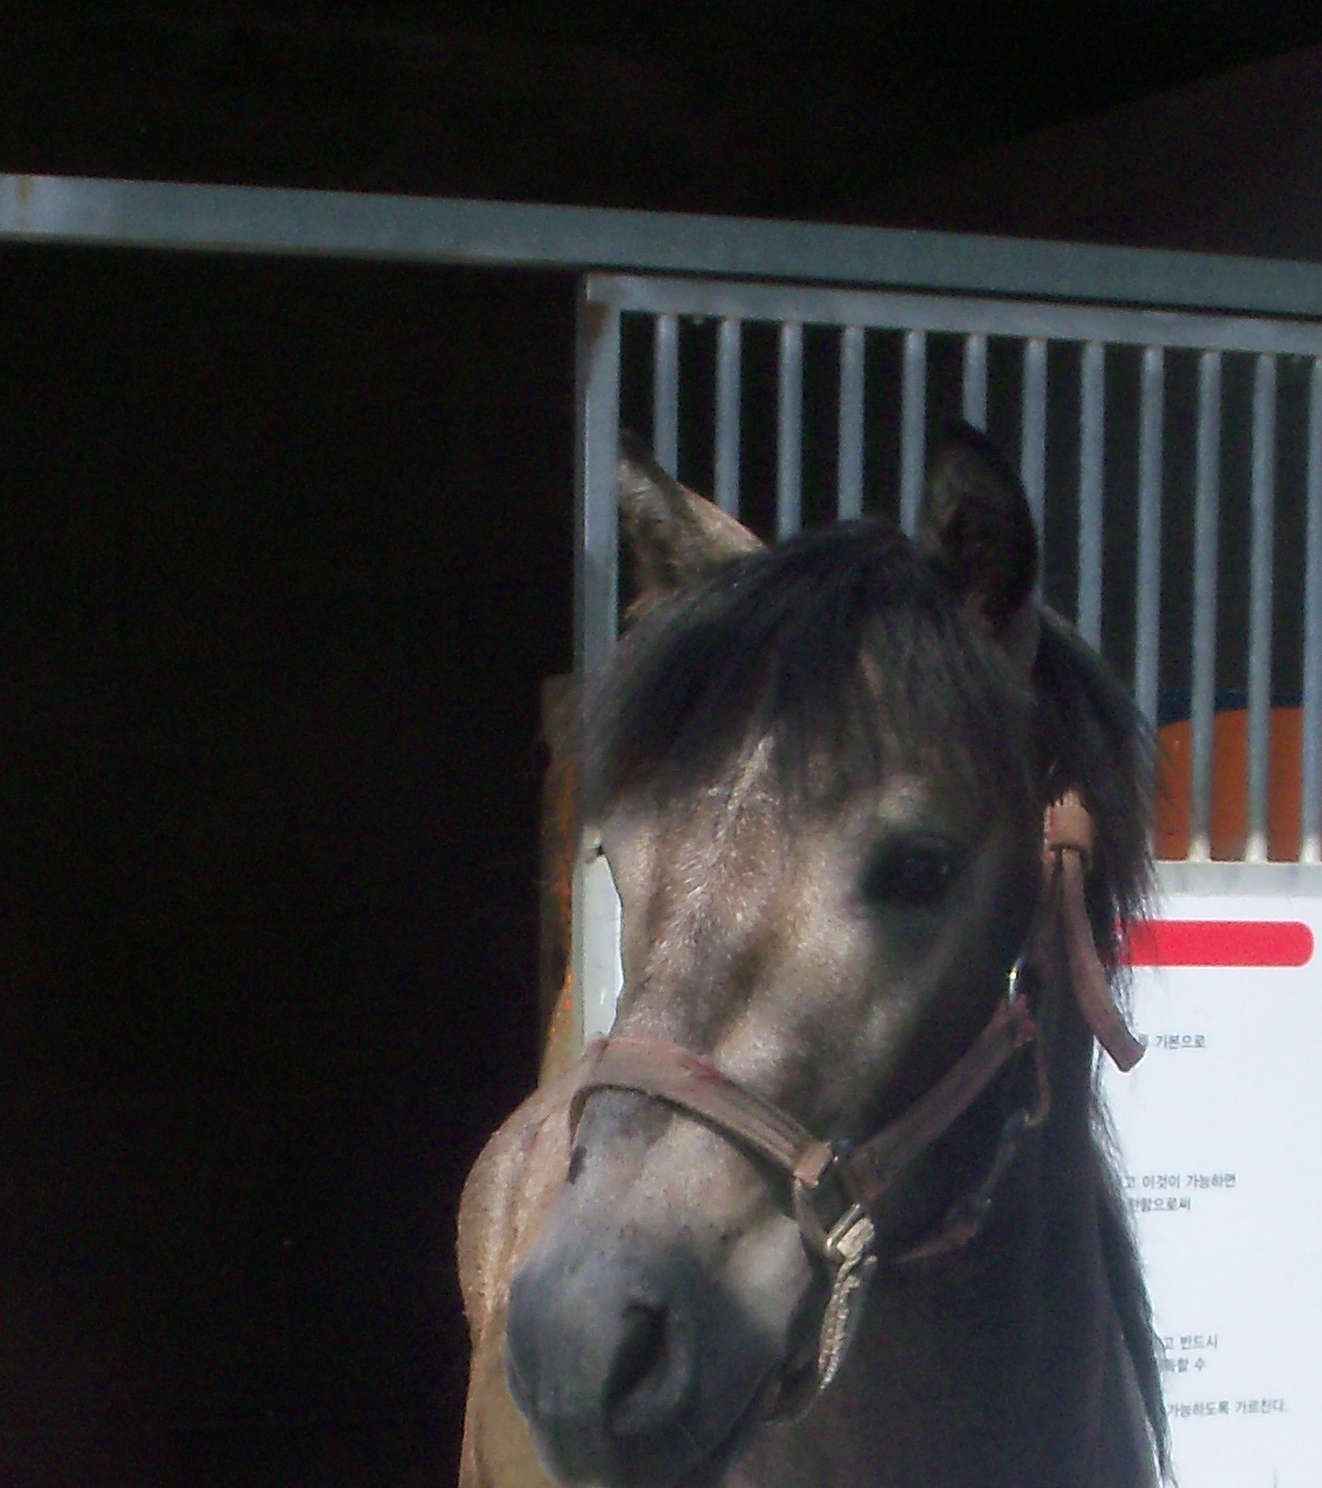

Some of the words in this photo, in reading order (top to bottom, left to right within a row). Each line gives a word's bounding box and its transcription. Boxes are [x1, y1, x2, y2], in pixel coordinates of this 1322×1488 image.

[1156, 1033, 1206, 1050] 기본으로
[1142, 1174, 1181, 1190] 이것이
[1186, 1172, 1237, 1189] 가능하면
[1180, 1333, 1219, 1350] 반드시
[1194, 1355, 1206, 1372] 수
[1168, 1401, 1230, 1418] 가능하도록
